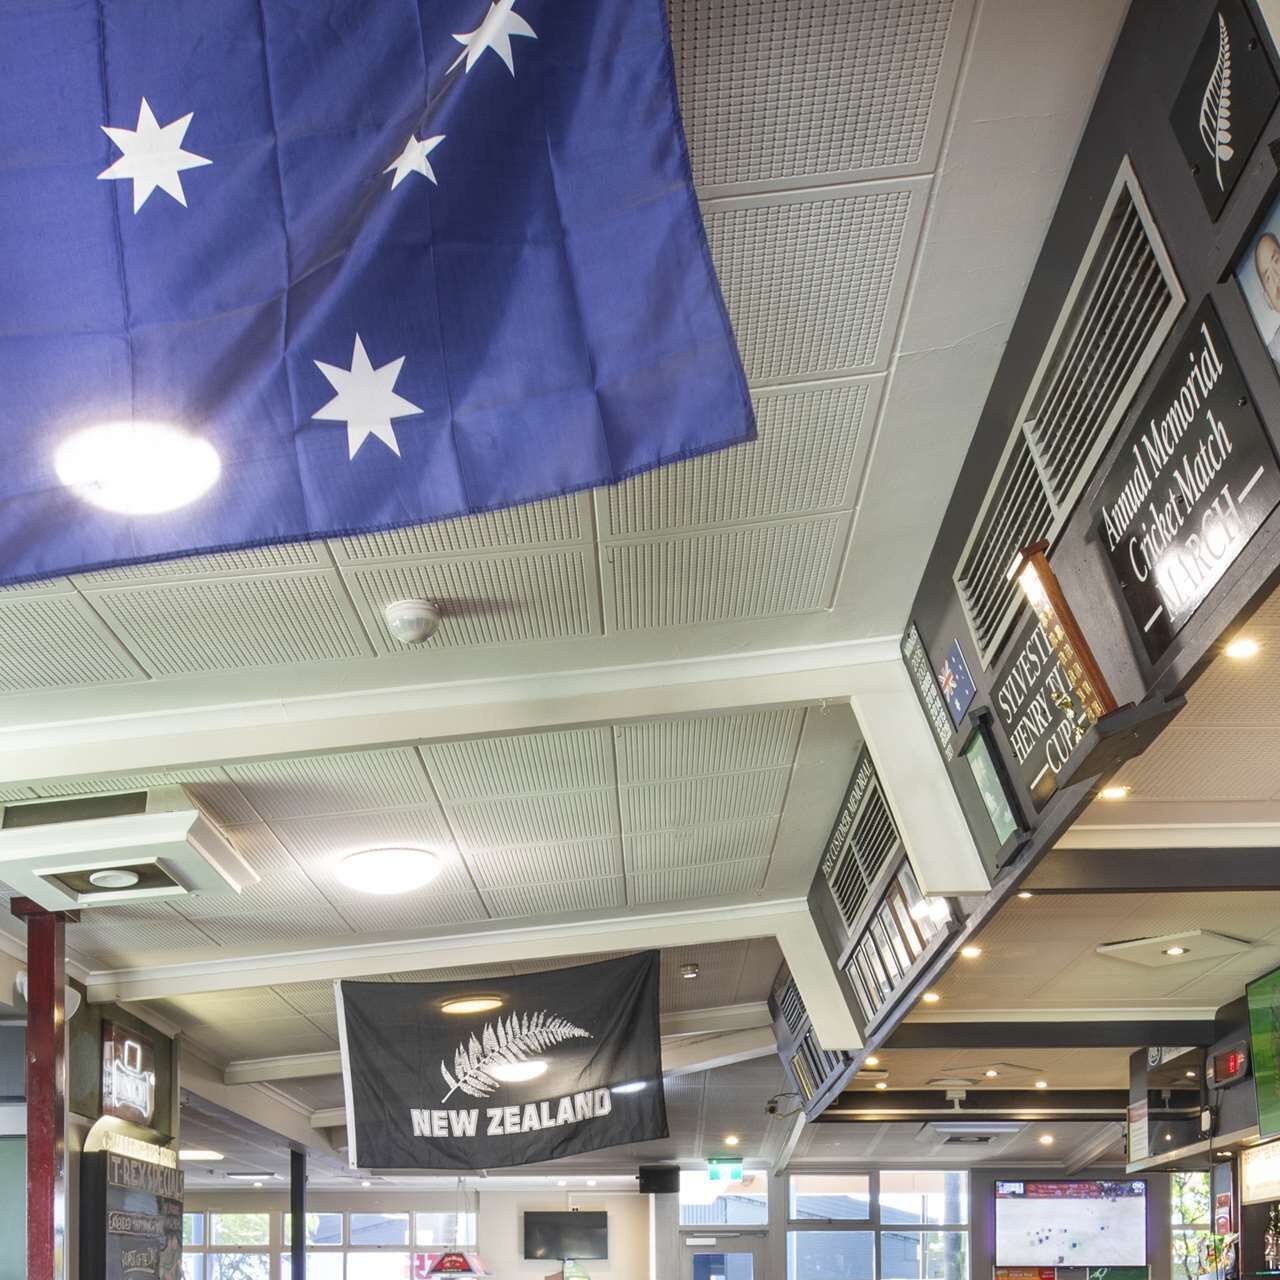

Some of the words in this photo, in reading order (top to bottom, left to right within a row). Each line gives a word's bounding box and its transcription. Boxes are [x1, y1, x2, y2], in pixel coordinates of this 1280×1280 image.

[1102, 443, 1153, 552] Annual
[1141, 321, 1224, 479] Memorial
[1128, 488, 1185, 583] Cricket
[1173, 409, 1233, 516] Match
[1156, 483, 1245, 624] MARCH
[1010, 687, 1053, 766] HENRY
[1045, 716, 1076, 775] CUP
[830, 809, 852, 860] CUSTOMER
[848, 758, 872, 816] MEMORIAL
[410, 1107, 479, 1137] NEW
[486, 1087, 612, 1136] ZEALAND
